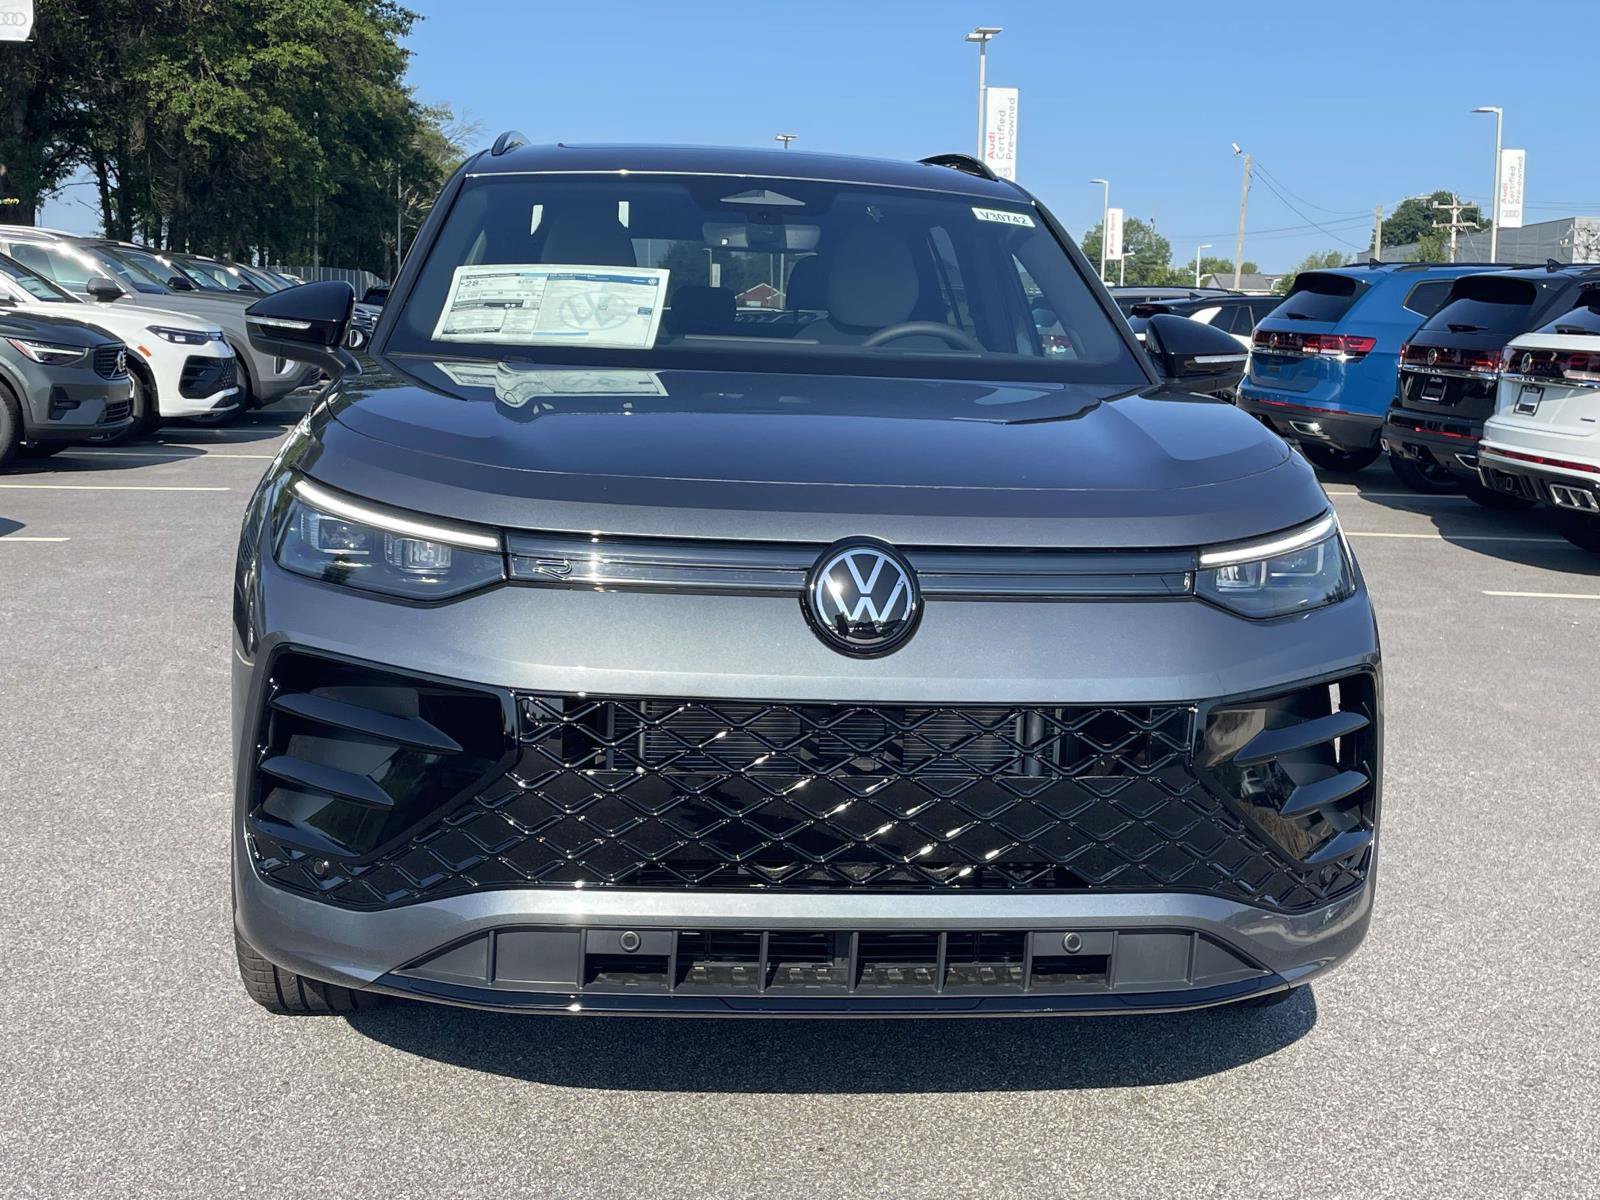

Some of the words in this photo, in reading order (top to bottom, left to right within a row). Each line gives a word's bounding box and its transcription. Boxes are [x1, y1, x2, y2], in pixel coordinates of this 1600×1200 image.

[987, 132, 996, 160] Audi
[996, 110, 1006, 160] Certified
[1005, 97, 1016, 160] Pre-owned
[979, 210, 1029, 225] V30742
